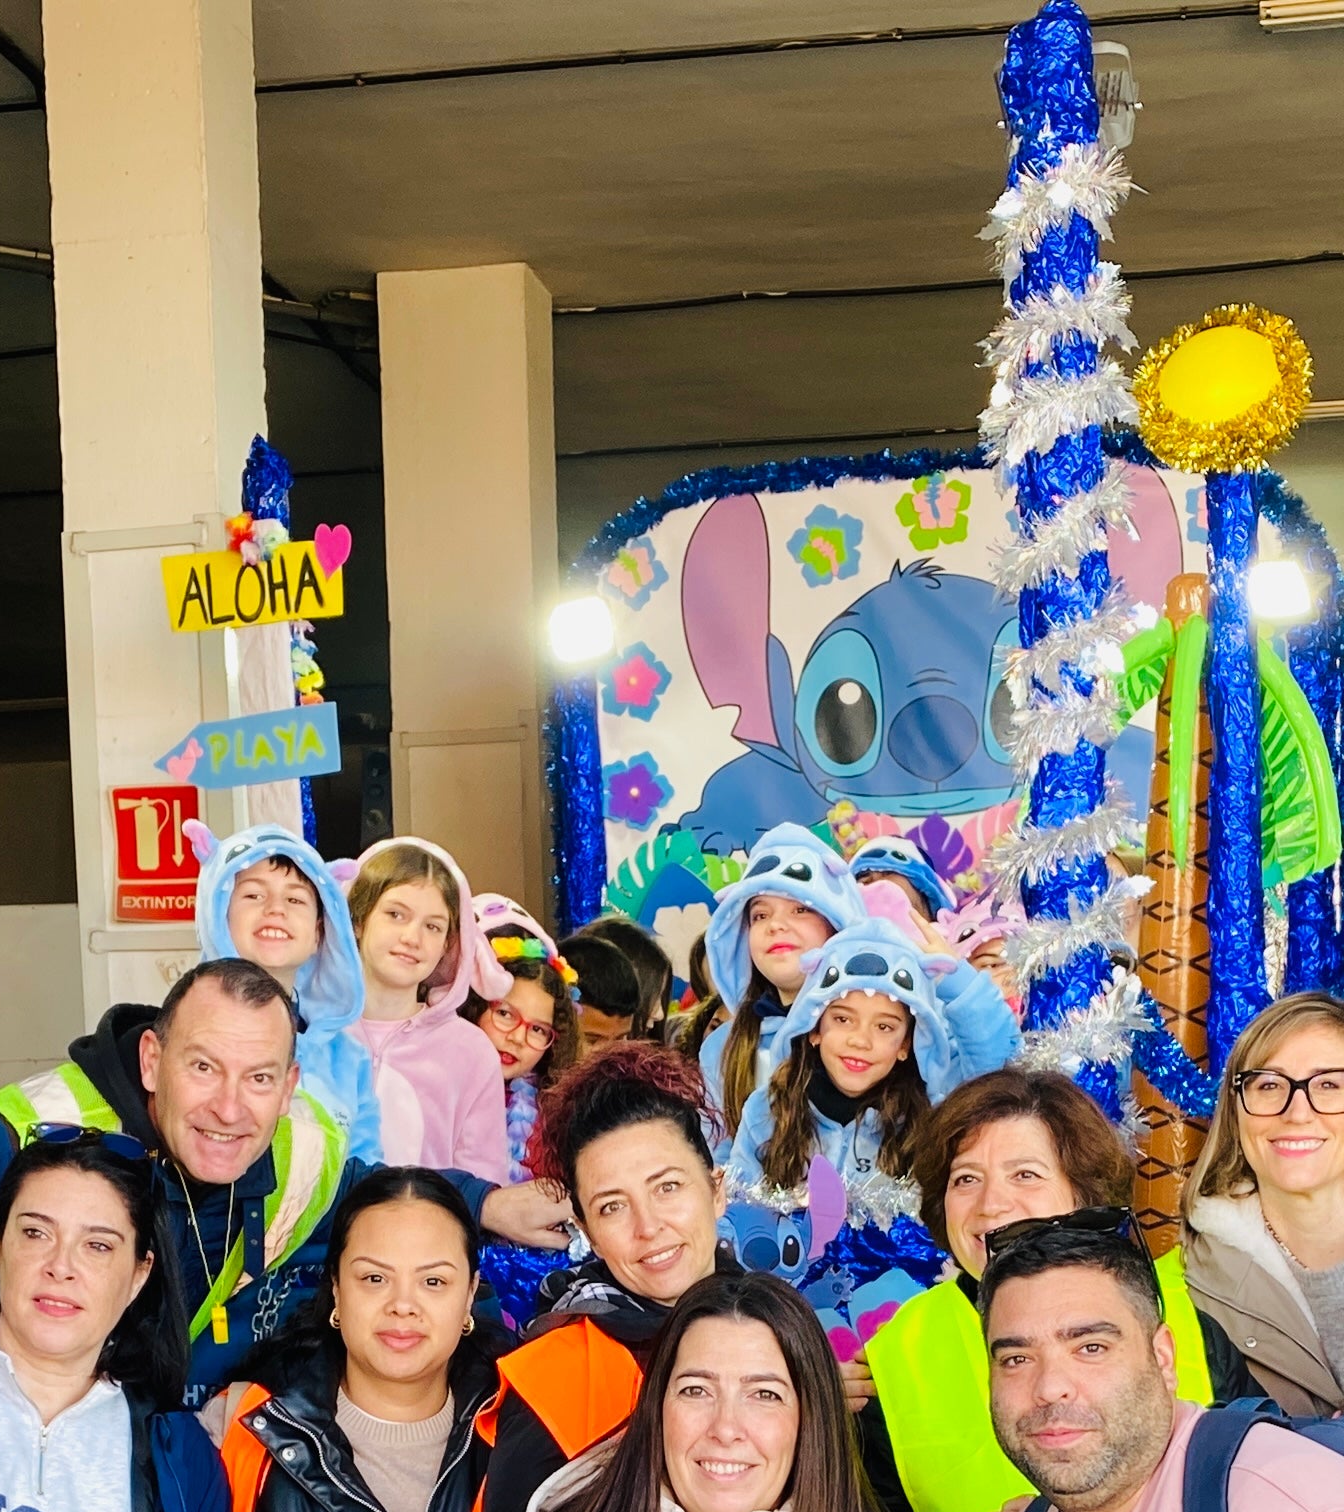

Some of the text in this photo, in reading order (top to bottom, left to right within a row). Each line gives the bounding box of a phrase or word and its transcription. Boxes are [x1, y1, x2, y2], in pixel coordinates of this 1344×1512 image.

[178, 552, 326, 628] ALOHA
[207, 721, 327, 776] PLAYA
[121, 895, 197, 909] EXTINTOR
